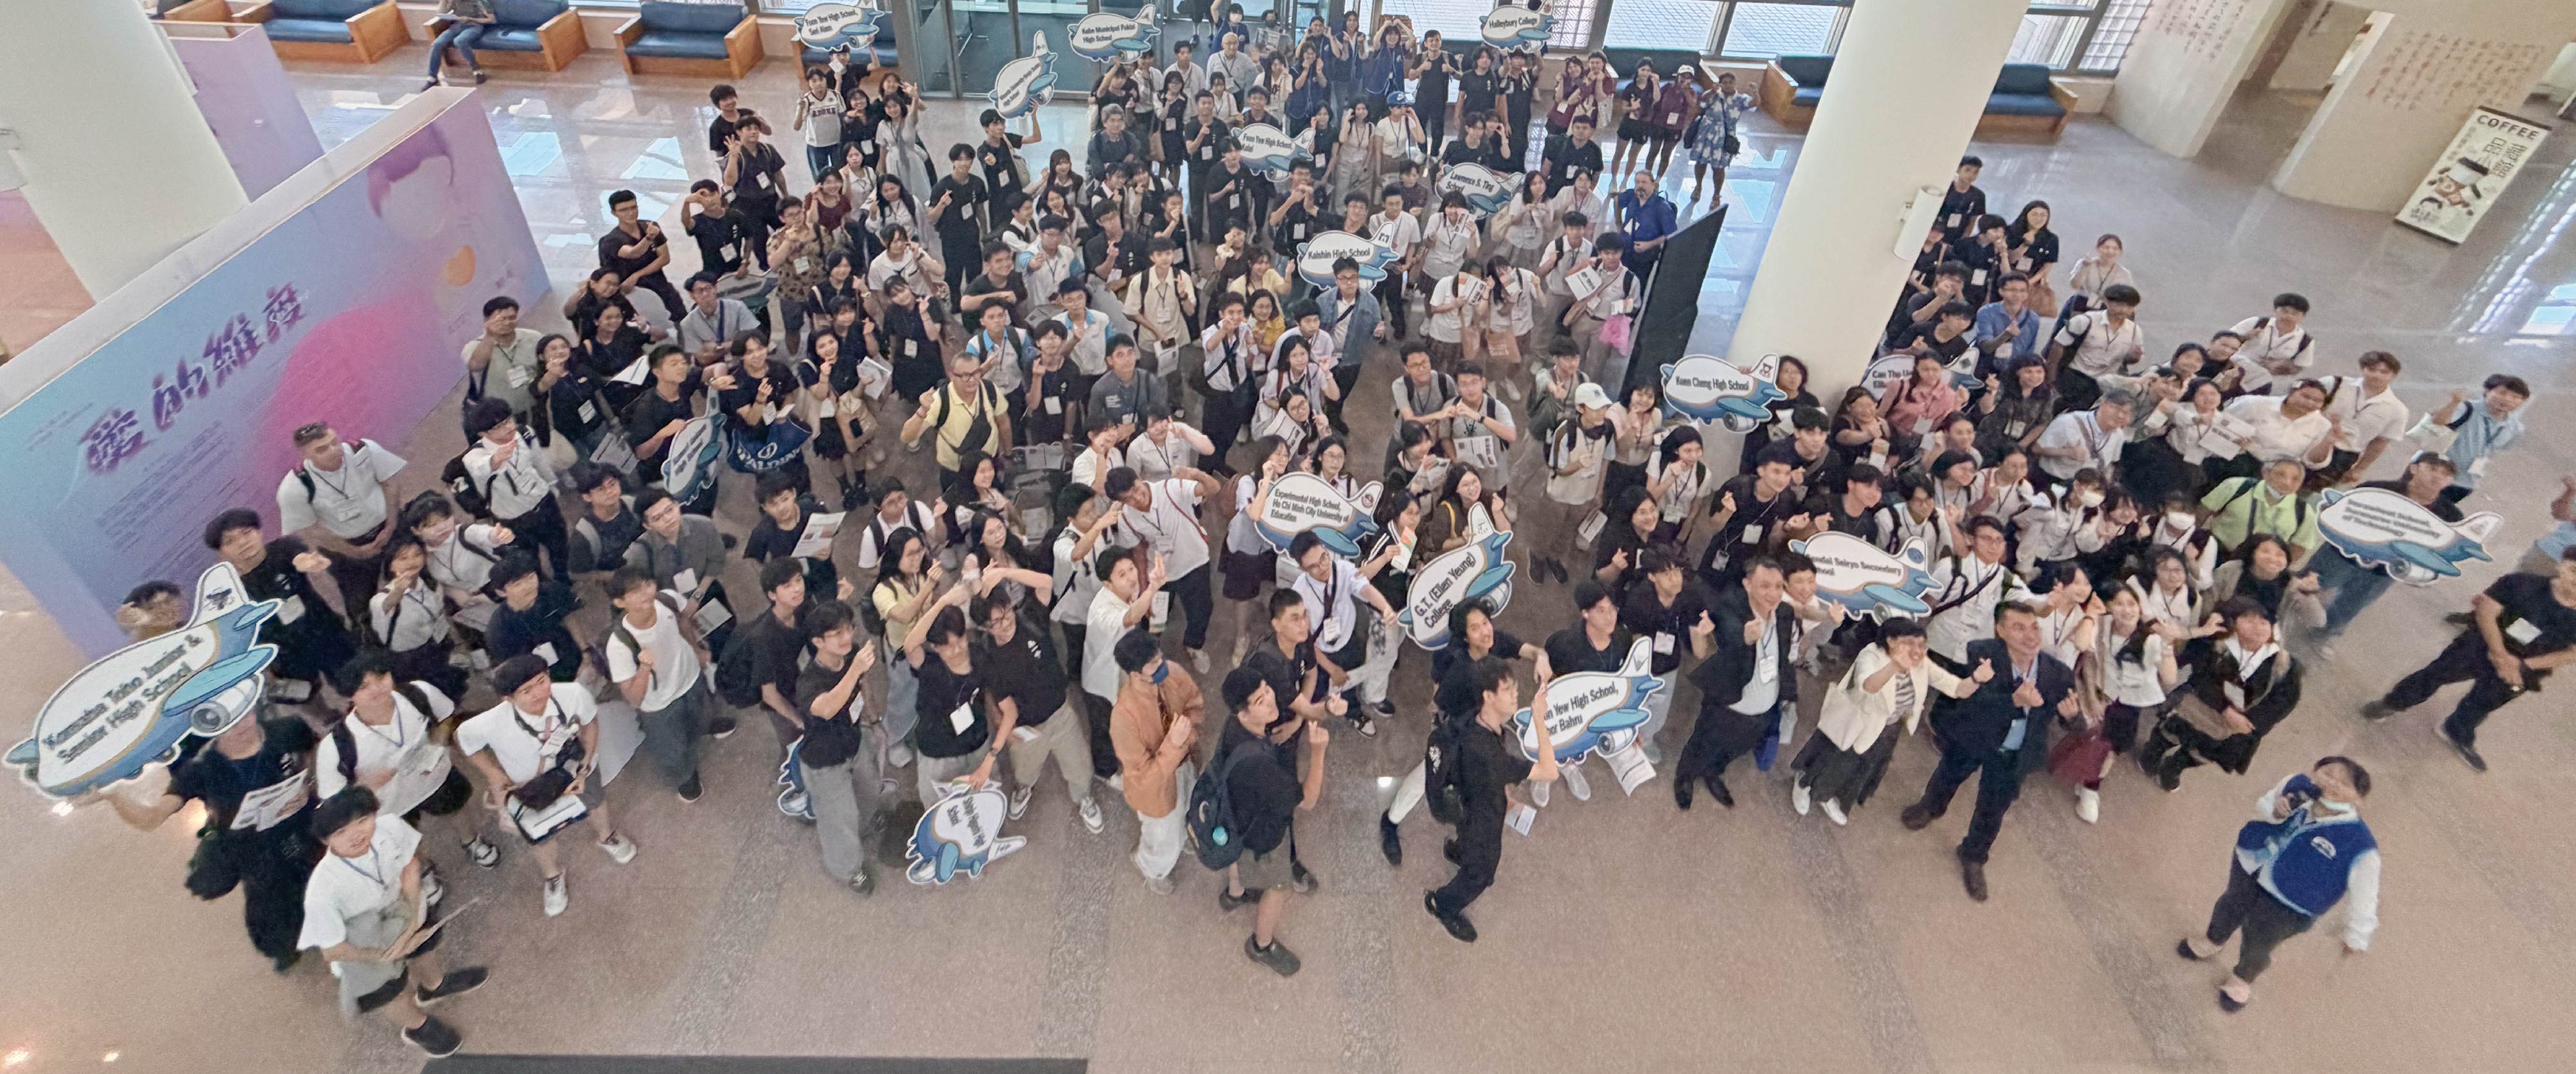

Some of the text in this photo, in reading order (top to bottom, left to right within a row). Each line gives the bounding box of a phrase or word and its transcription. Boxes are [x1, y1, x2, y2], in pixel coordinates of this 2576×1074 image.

[827, 13, 840, 21] High
[1518, 17, 1537, 26] College
[2477, 115, 2539, 140] COFFEE
[1264, 137, 1275, 147] High
[1445, 181, 1465, 191] School
[1333, 250, 1348, 258] High
[1349, 247, 1370, 257] School
[77, 282, 305, 475] 愛的維度
[1713, 379, 1727, 391] High
[1728, 379, 1749, 391] School
[1275, 489, 1309, 504] Experimental
[1309, 496, 1322, 507] High
[1270, 509, 1297, 523] Education
[1272, 498, 1349, 523] Ho Chi Minh City University of
[1429, 577, 1453, 603] (Ellen
[1448, 551, 1476, 580] Yeung)
[1860, 561, 1901, 576] Secondary
[1424, 599, 1453, 628] College
[104, 677, 144, 702] Toho
[141, 645, 187, 679] Junior
[185, 634, 204, 647] &
[1553, 702, 1569, 715] Yew
[1570, 693, 1589, 709] High
[1590, 681, 1619, 702] School,
[57, 661, 193, 765] Senior High School
[1559, 714, 1583, 731] Bahru
